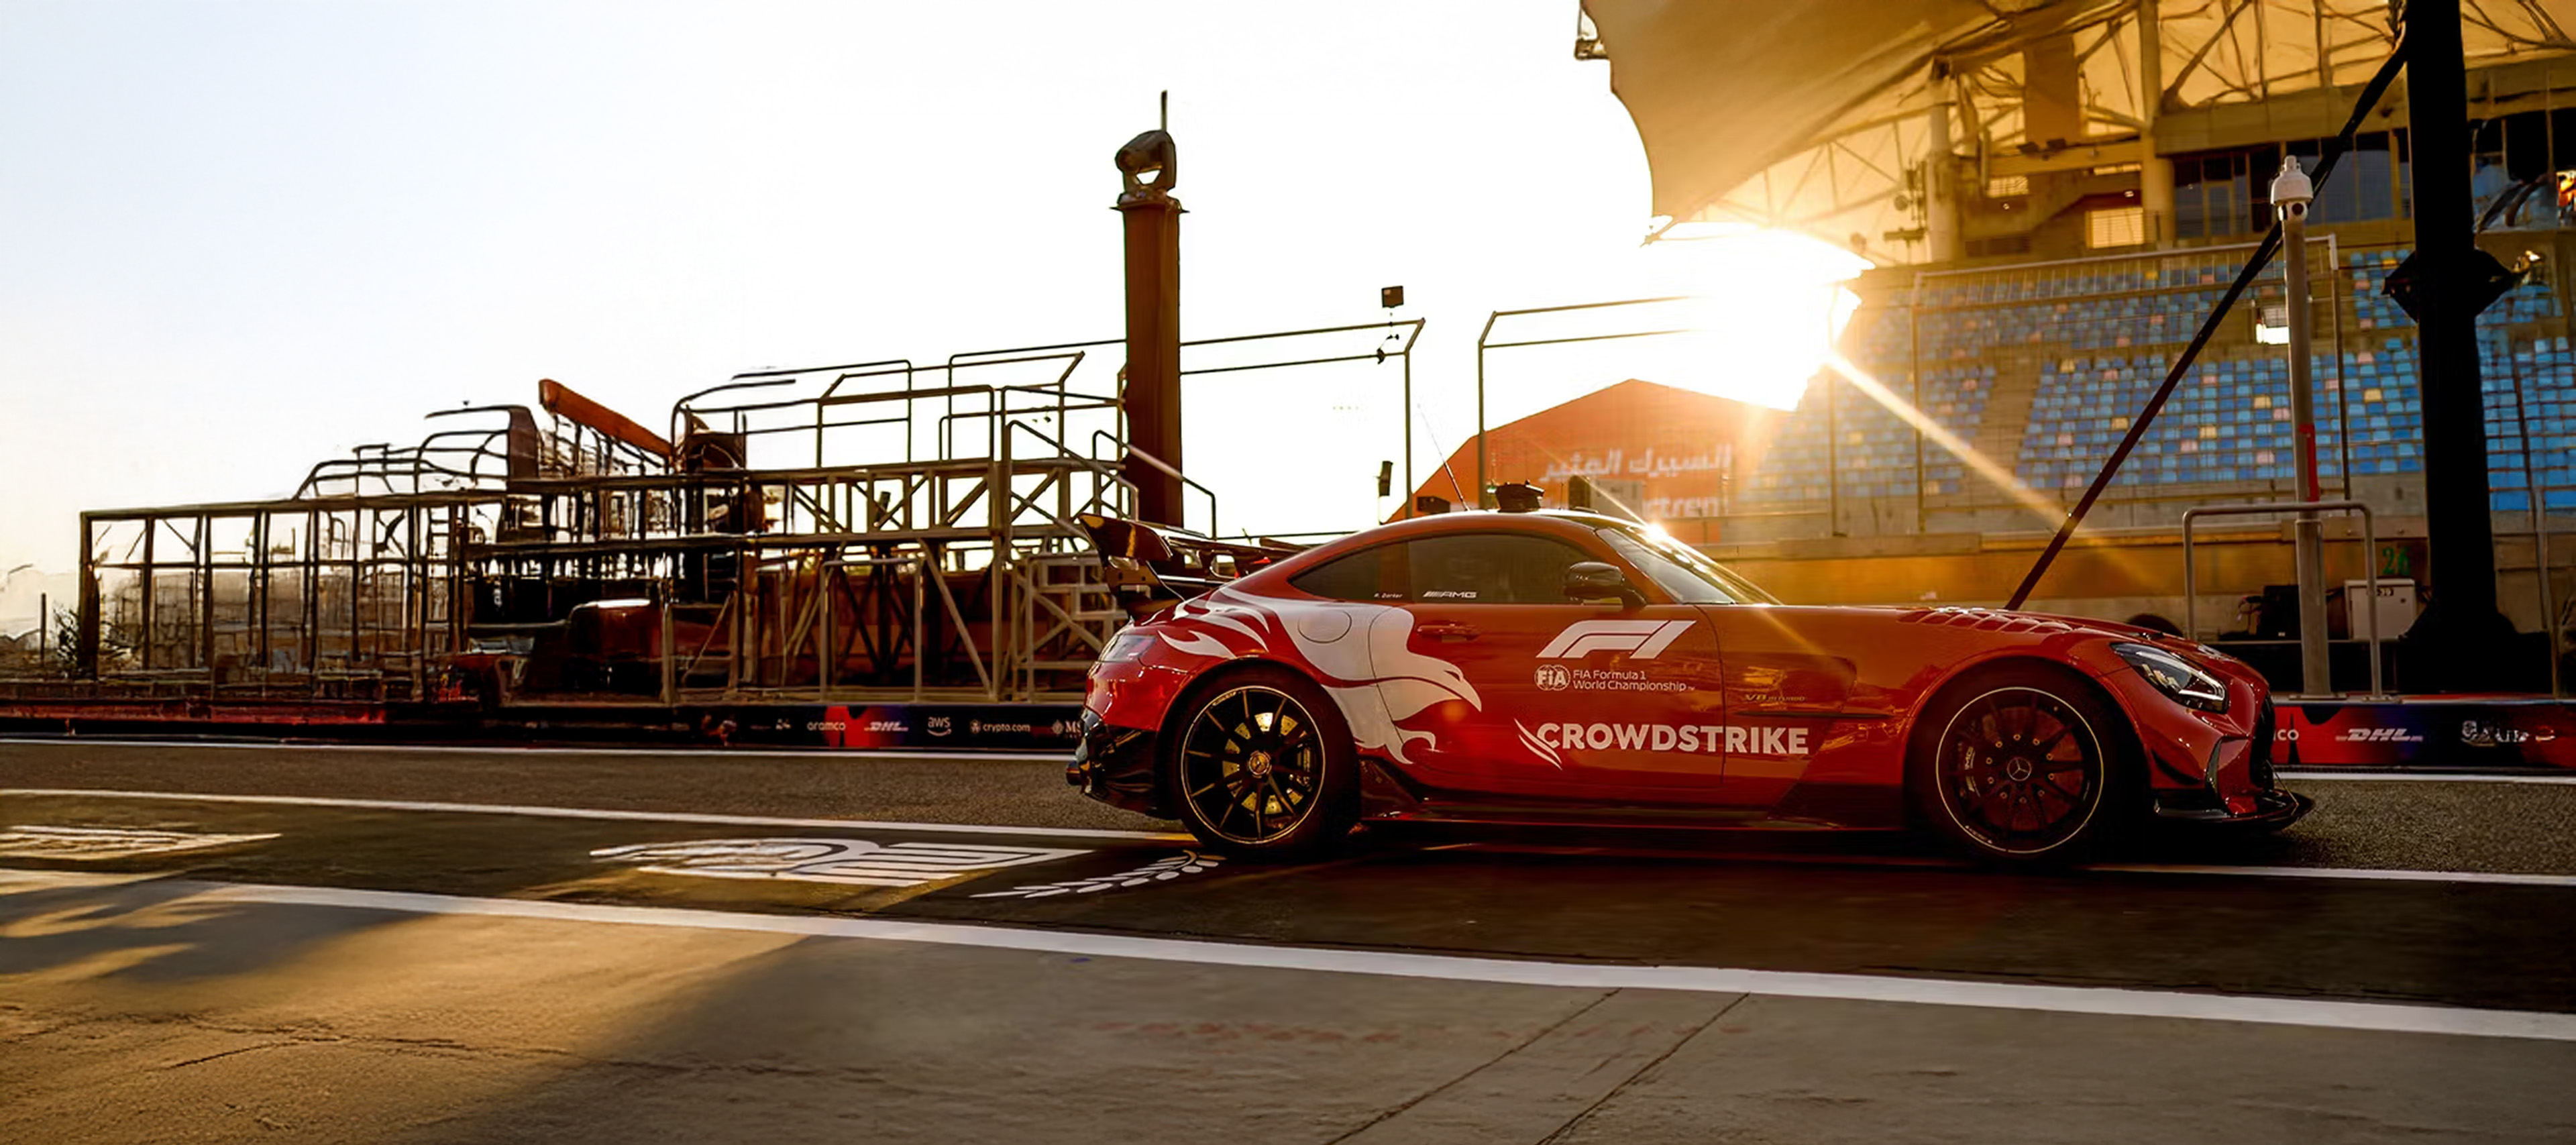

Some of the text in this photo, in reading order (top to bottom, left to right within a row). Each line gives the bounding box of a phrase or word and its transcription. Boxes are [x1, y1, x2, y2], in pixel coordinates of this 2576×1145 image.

[2381, 546, 2410, 576] 26
[1536, 620, 1697, 659] F1
[1573, 670, 1646, 680] FIA Formula 1
[1573, 680, 1686, 692] World Championship
[807, 721, 846, 731] aramco
[869, 721, 904, 732] DHL
[928, 716, 951, 728] aws
[982, 722, 1031, 732] crypto.com
[1065, 720, 1082, 733] MS
[1536, 722, 1809, 755] CROWDSTRIKE
[2347, 728, 2413, 742] DHL
